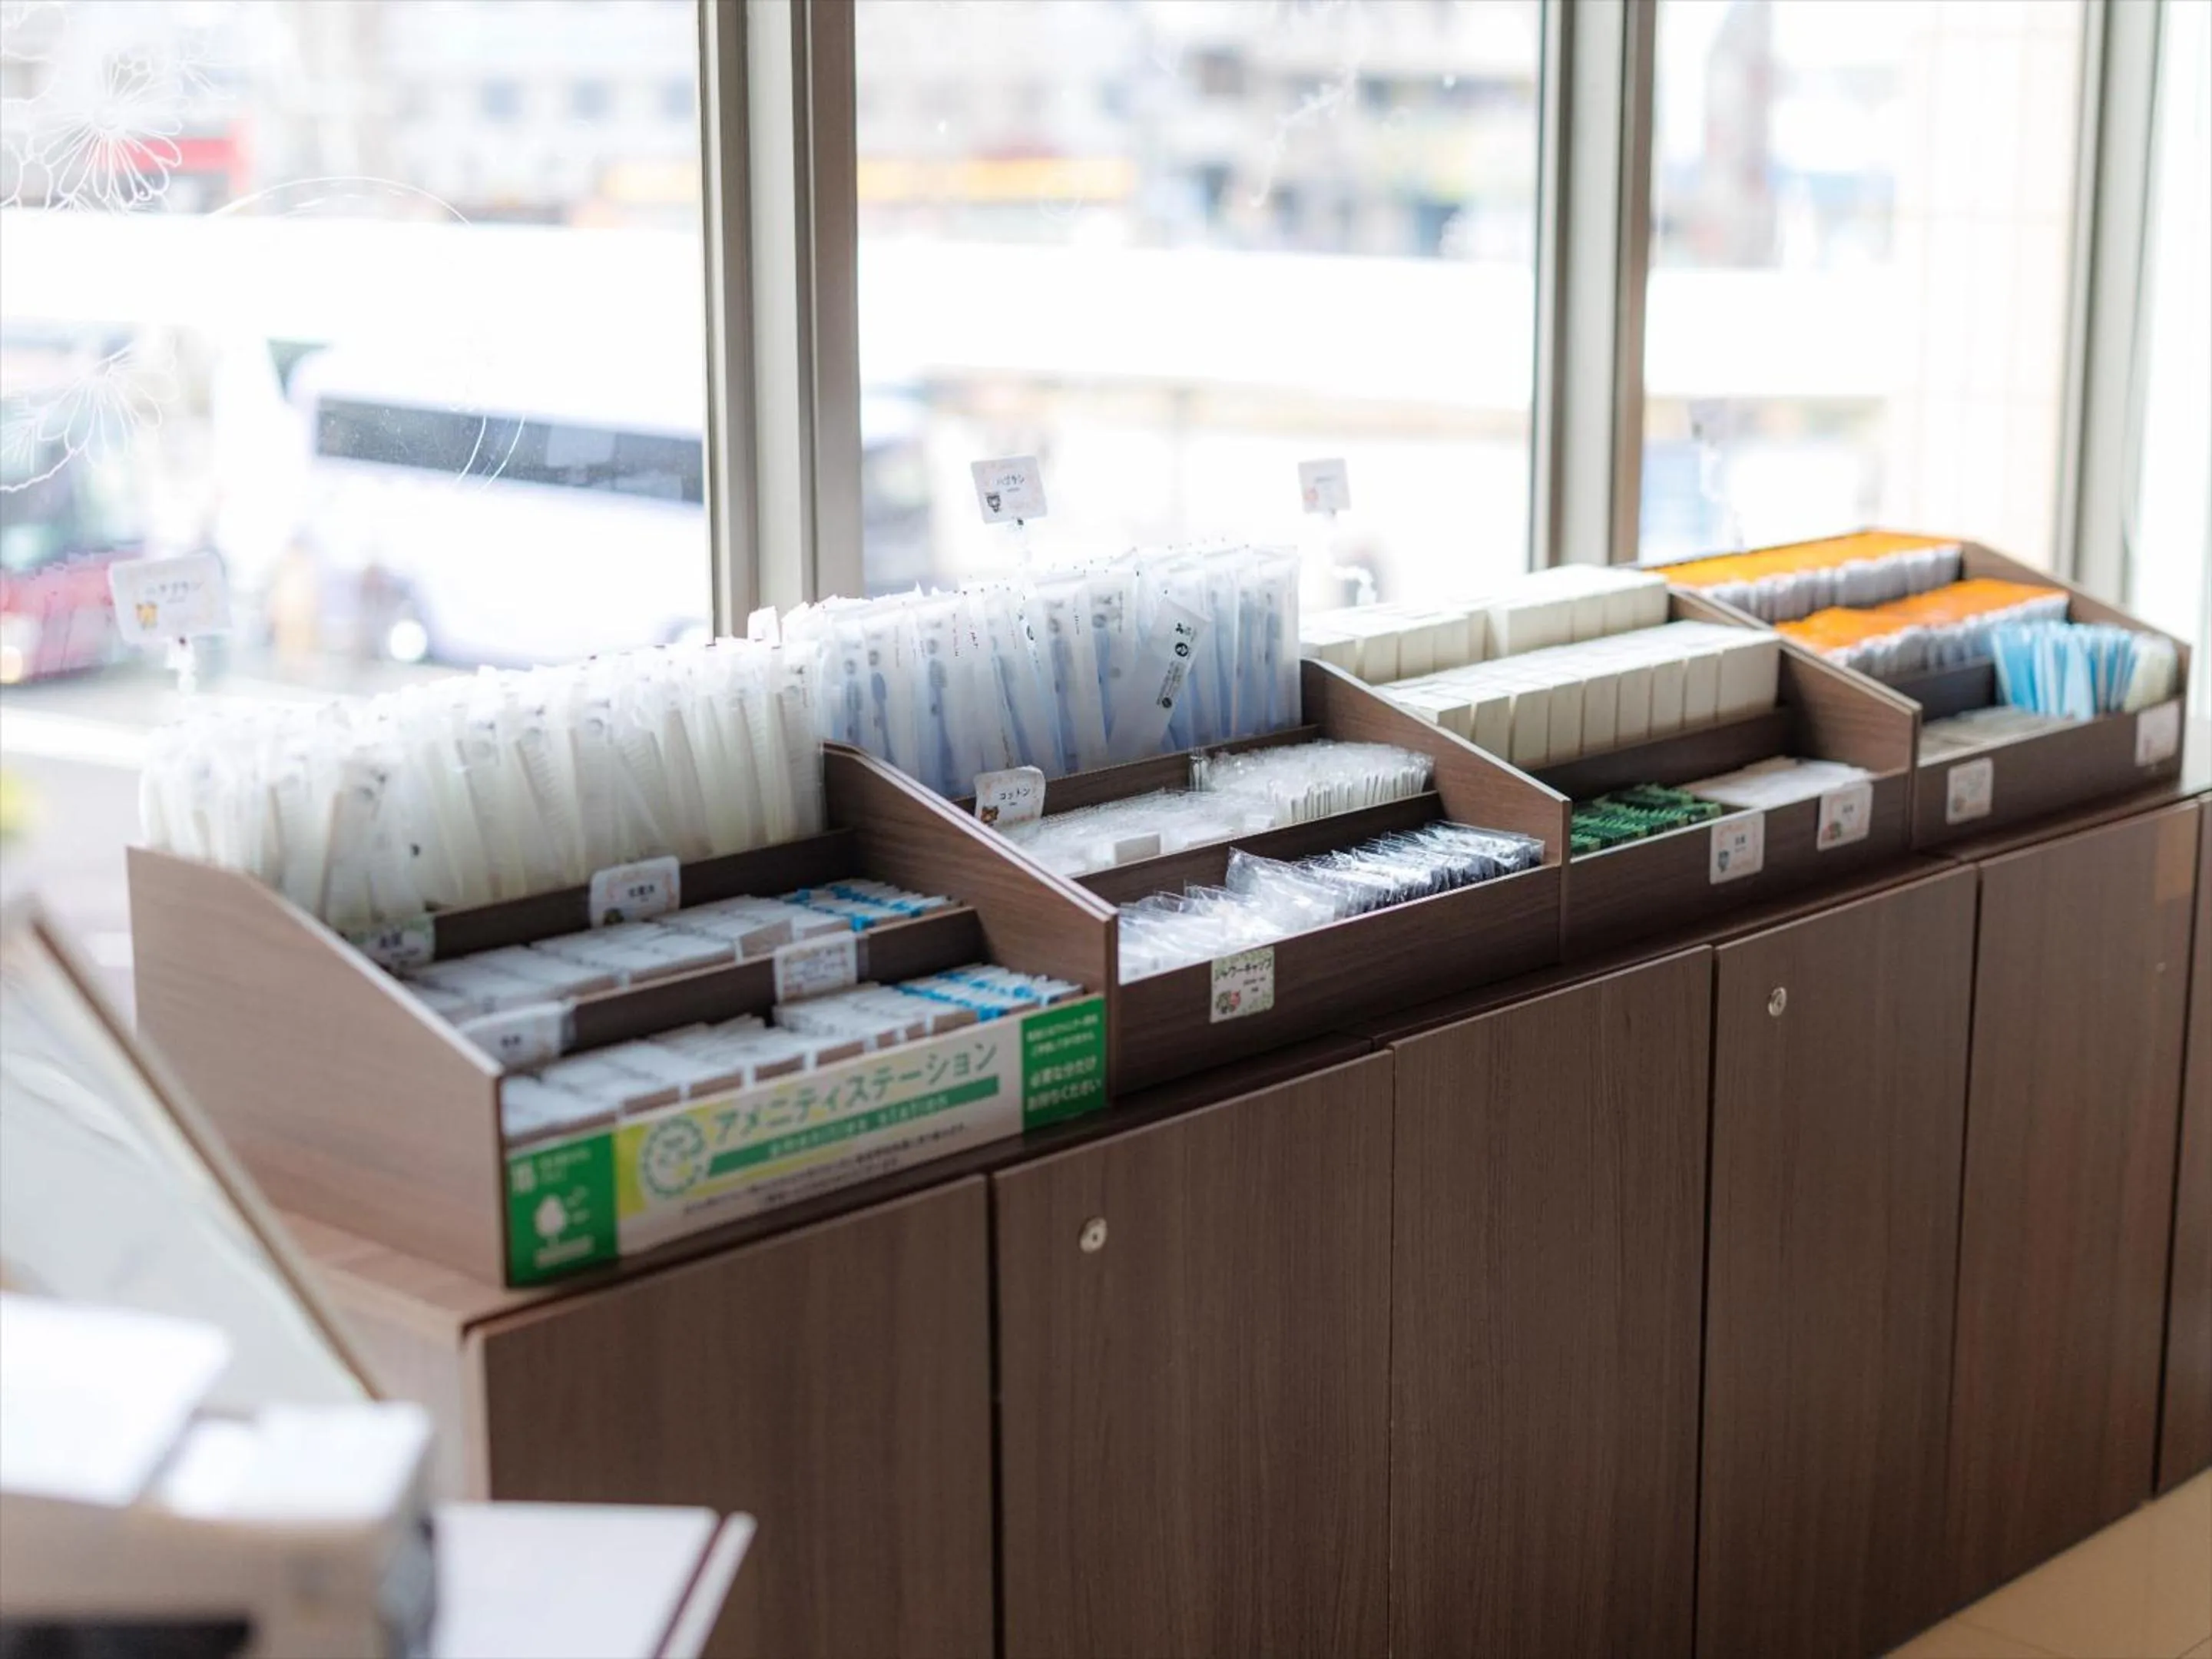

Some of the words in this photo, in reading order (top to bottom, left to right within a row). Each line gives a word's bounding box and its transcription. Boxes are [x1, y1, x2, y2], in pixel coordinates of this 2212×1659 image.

[714, 1042, 998, 1145] アメニティステーション
